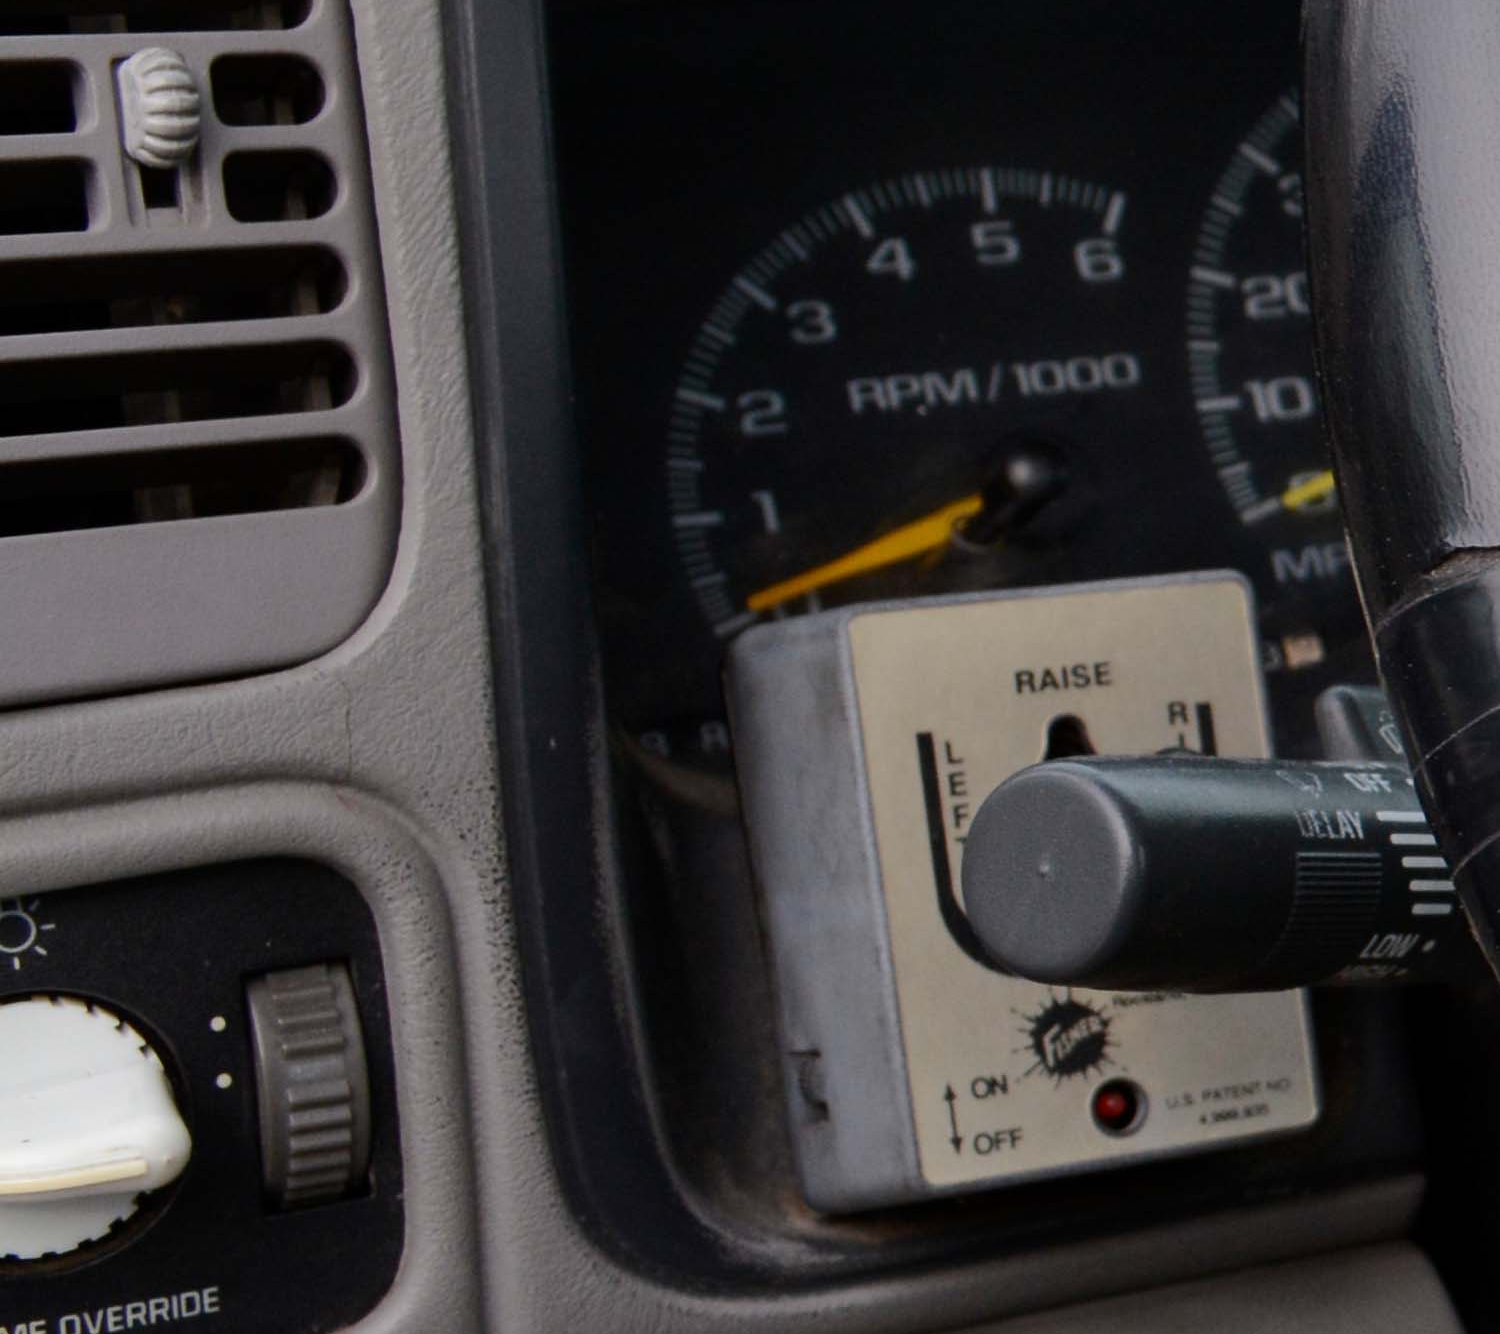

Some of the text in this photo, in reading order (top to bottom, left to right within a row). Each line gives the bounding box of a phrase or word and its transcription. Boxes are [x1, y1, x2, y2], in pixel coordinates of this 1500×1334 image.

[867, 238, 916, 282] 4
[970, 221, 1020, 265] 5
[1074, 239, 1124, 283] 6
[787, 300, 838, 344] 3
[737, 389, 788, 437] 2
[1244, 375, 1314, 421] 10
[751, 489, 779, 533] 1
[1015, 662, 1113, 694] RAISE
[1344, 772, 1392, 792] OFF
[1296, 809, 1364, 840] DELAY
[1360, 933, 1419, 959] LOW
[970, 1075, 1009, 1100] ON
[1201, 1080, 1262, 1101] PATENT
[973, 1128, 1024, 1156] OFF
